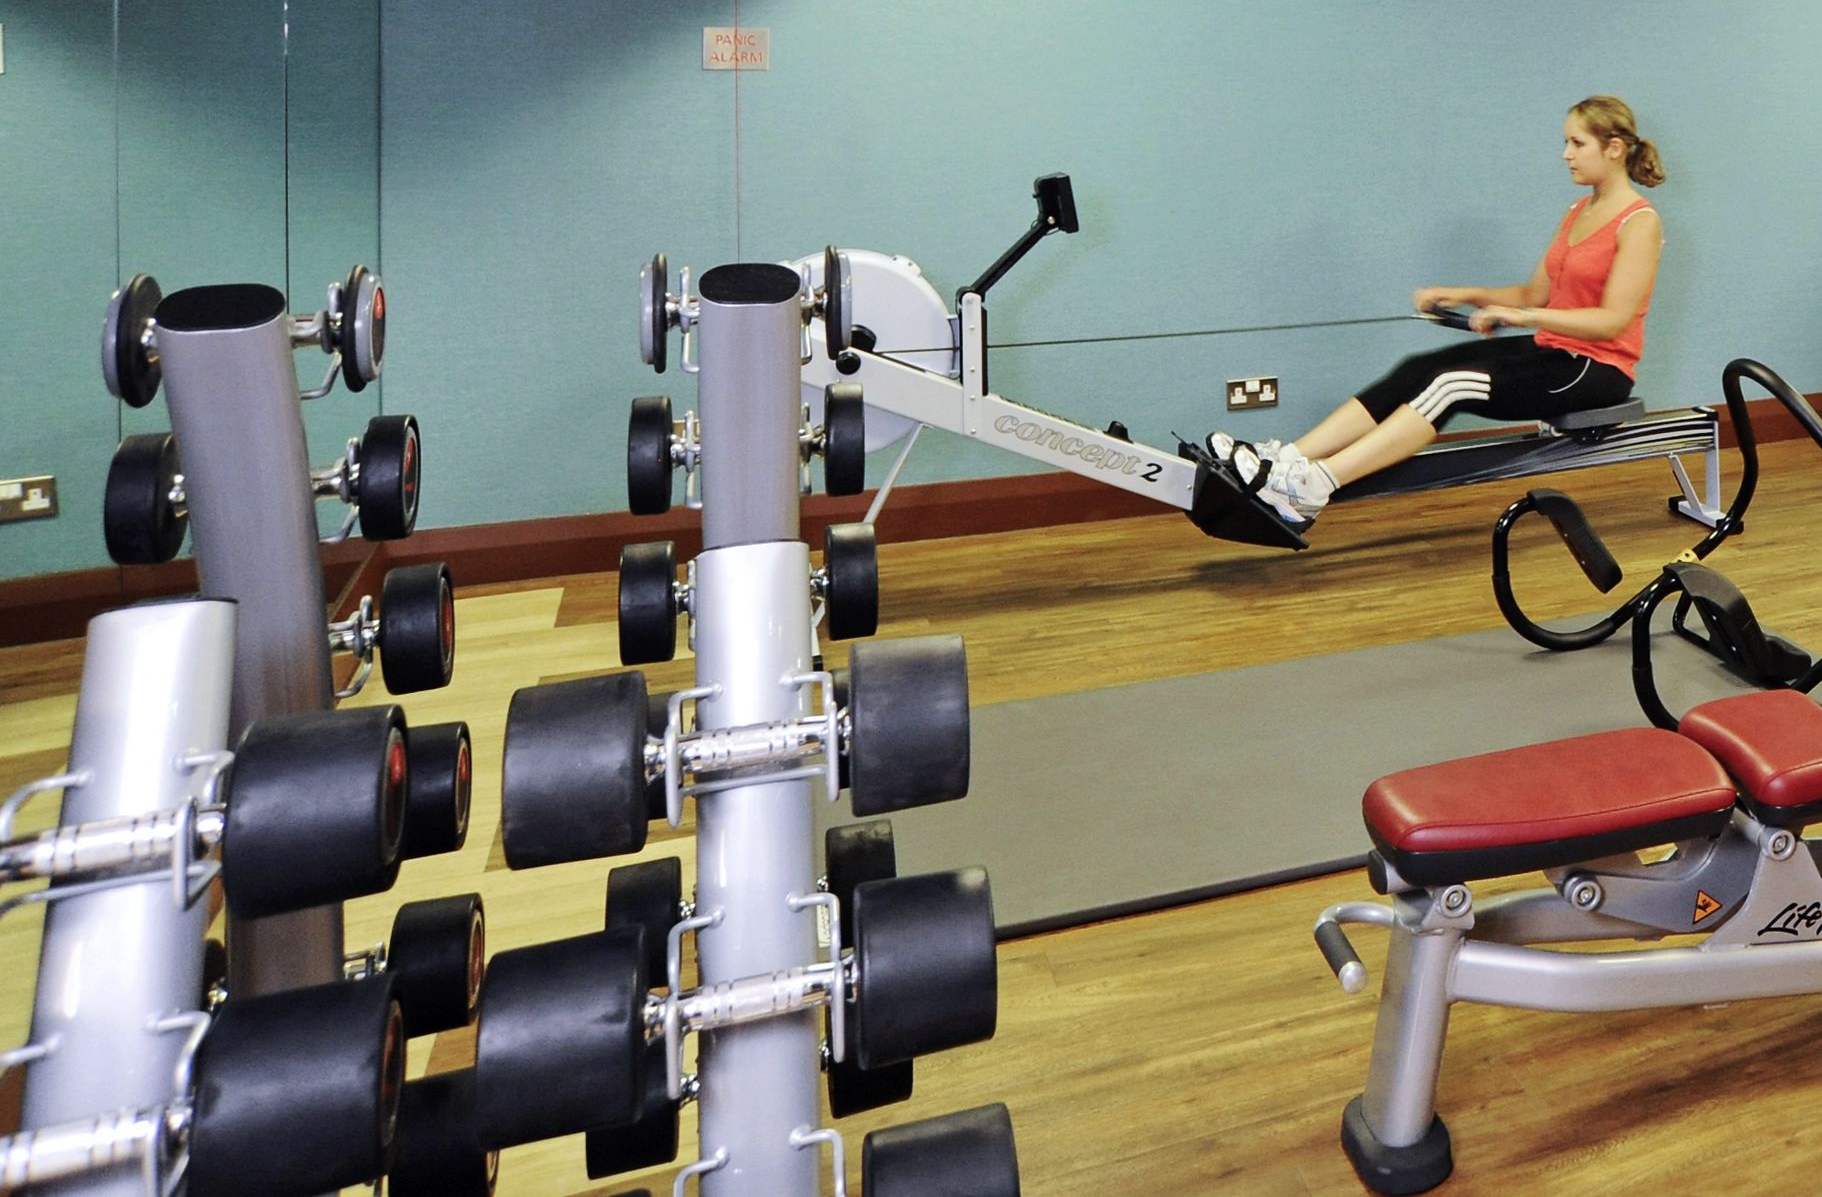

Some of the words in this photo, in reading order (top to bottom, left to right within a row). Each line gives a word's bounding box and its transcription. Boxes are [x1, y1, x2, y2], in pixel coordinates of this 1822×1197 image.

[715, 34, 756, 46] PANIC
[710, 52, 763, 63] ALARM
[1140, 462, 1163, 483] 2
[1757, 902, 1822, 937] Life
